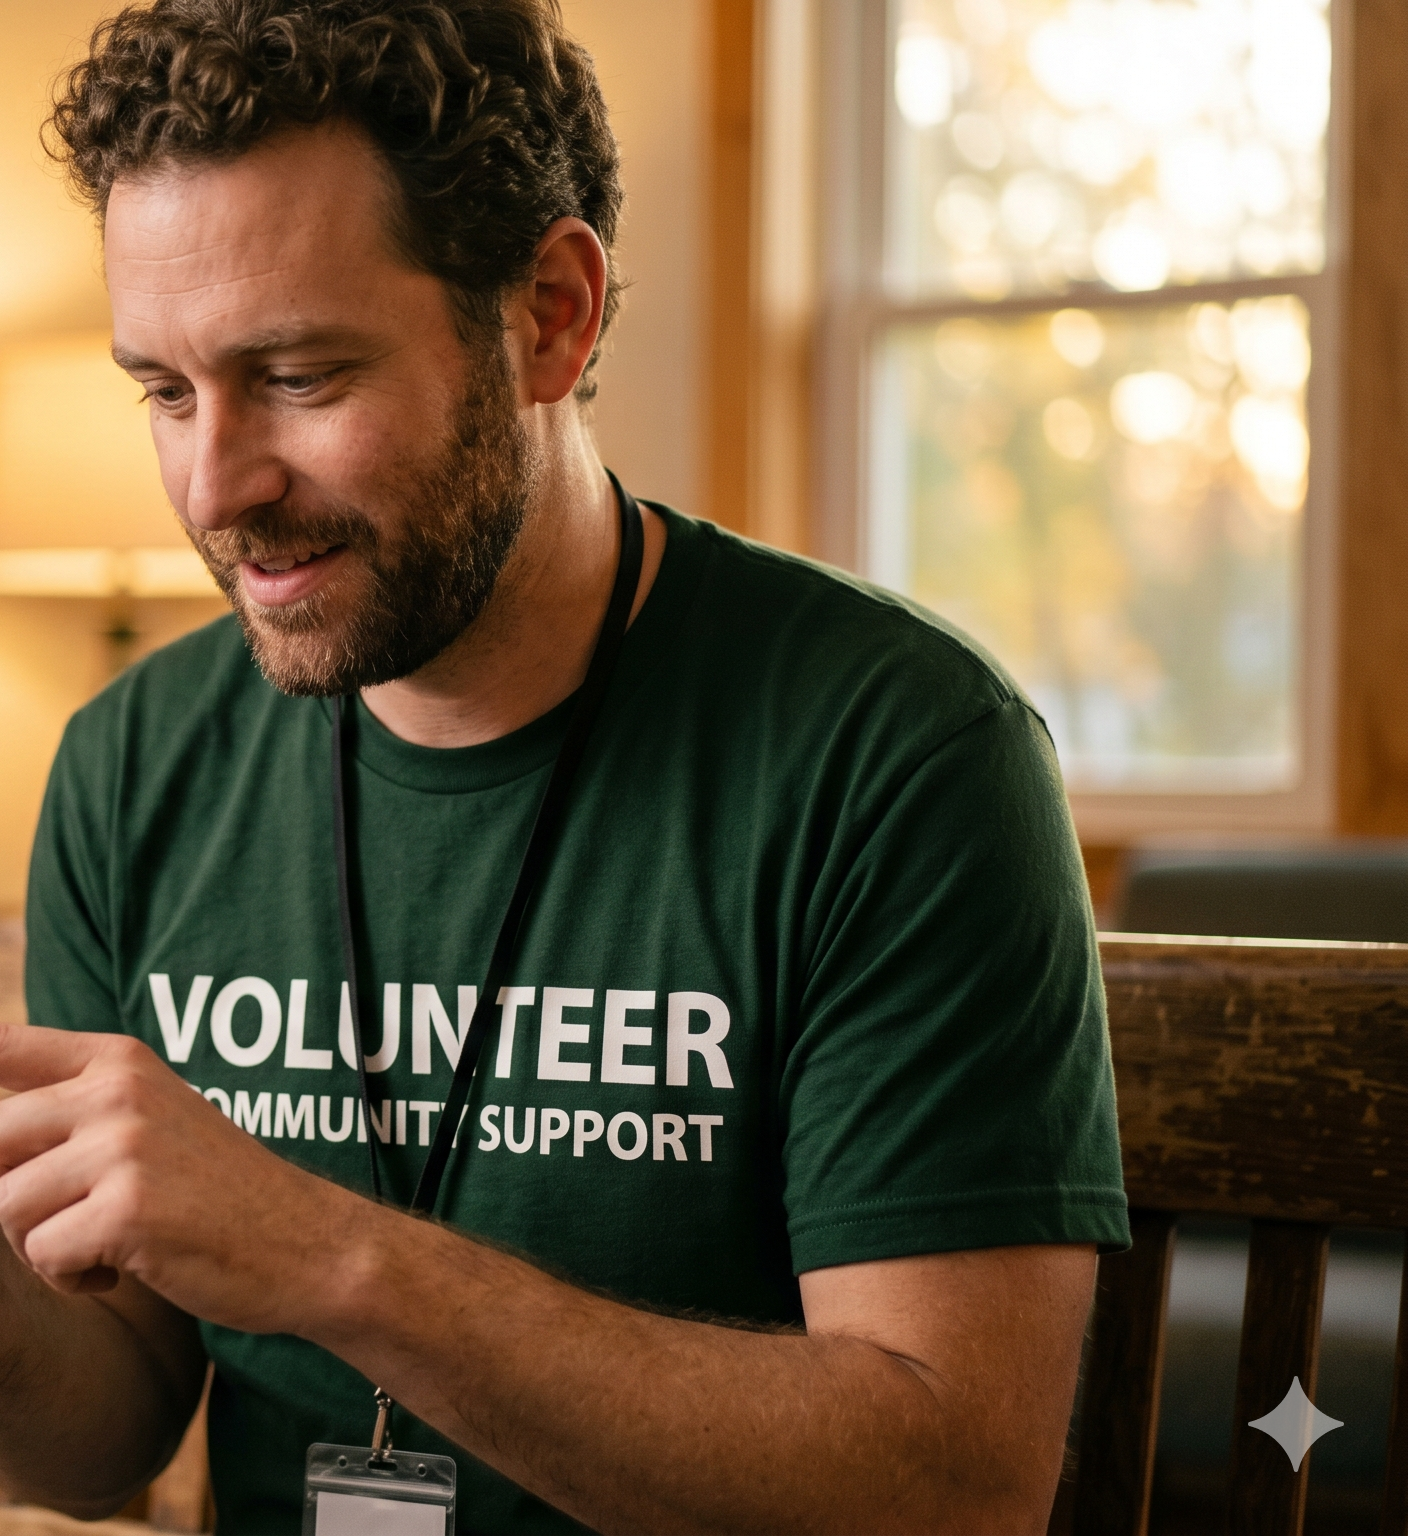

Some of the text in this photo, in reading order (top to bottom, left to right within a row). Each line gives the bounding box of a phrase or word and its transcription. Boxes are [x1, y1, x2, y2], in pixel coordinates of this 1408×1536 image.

[147, 972, 735, 1089] VOLUNTEER
[186, 1083, 724, 1162] OMMUNIT SUPPORT
